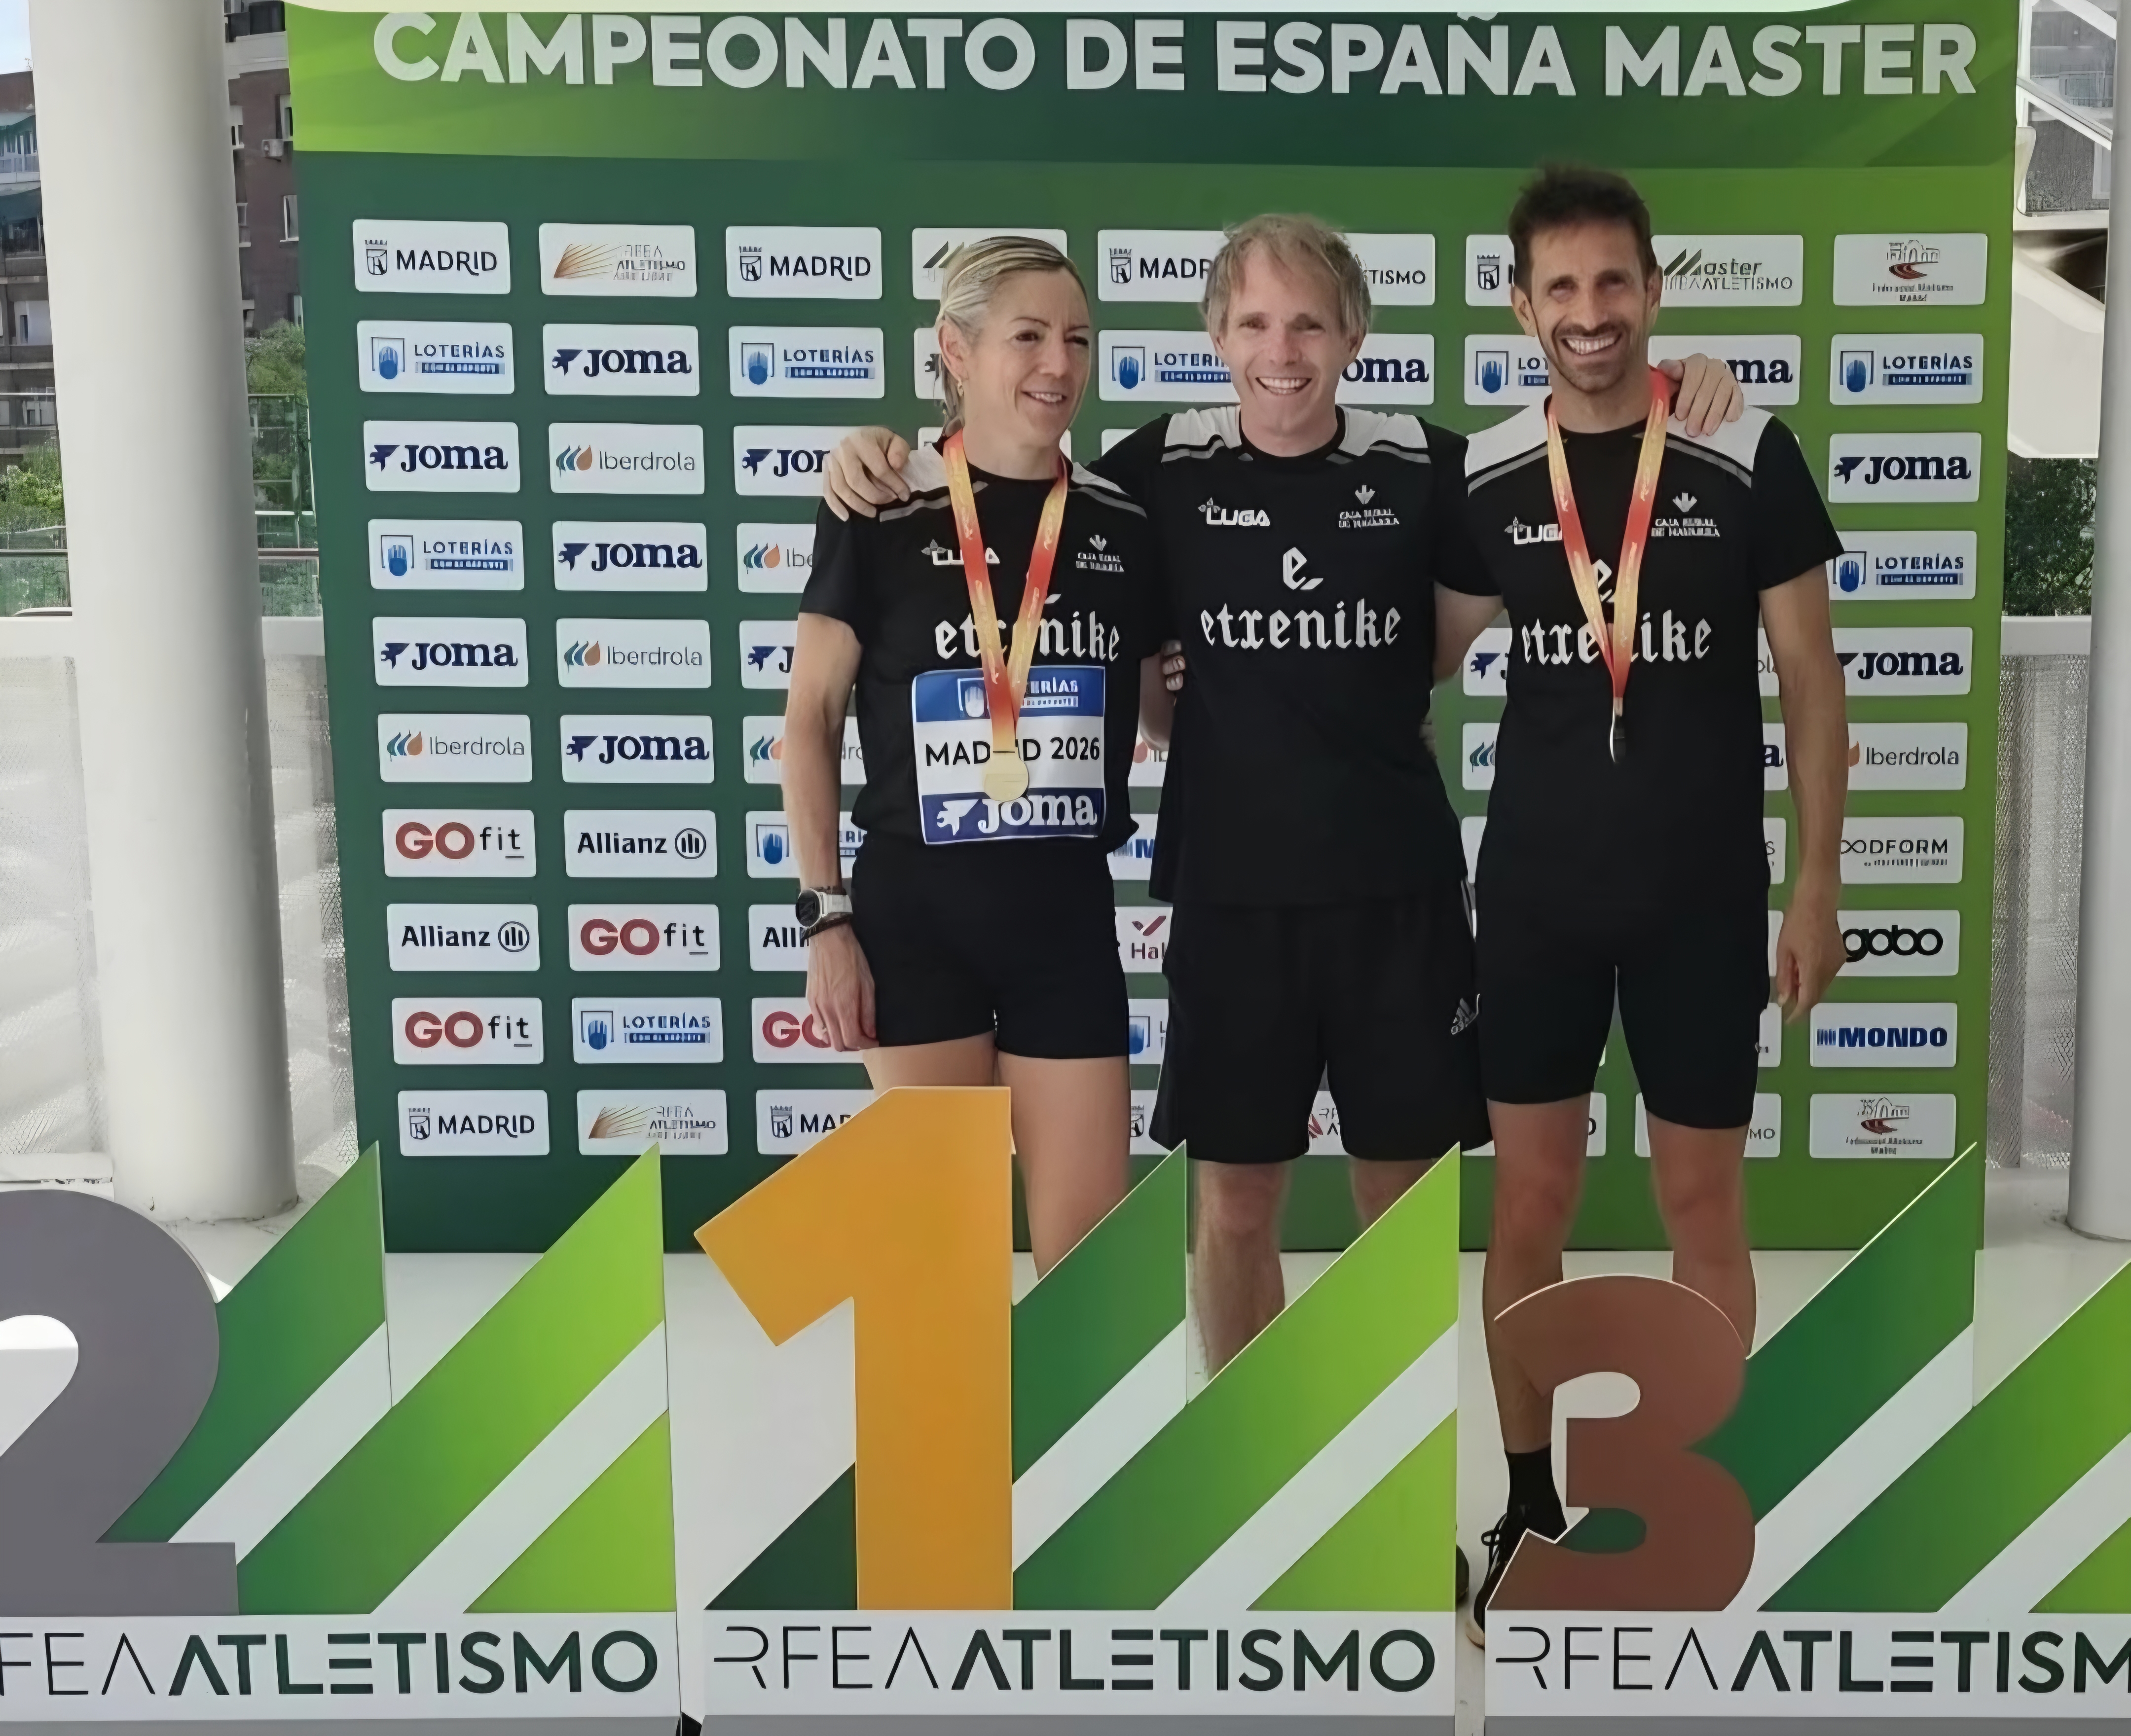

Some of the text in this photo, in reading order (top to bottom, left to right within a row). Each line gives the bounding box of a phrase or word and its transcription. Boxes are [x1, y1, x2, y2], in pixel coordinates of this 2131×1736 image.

[373, 12, 1977, 97] CAMPEONATO DE ESPAÑA MASTER
[396, 250, 497, 277] MADRID
[771, 255, 871, 282] MADRID
[1139, 257, 1212, 279] MADR
[1368, 269, 1426, 285] TISMO
[1341, 358, 1430, 383] oma
[1726, 359, 1793, 384] ma
[599, 450, 695, 471] Iberdrola
[935, 611, 1120, 662] etnike
[1200, 598, 1401, 650] etxenike
[1521, 609, 1712, 665] etxeike
[607, 645, 702, 666] Iberdrola
[430, 735, 525, 756] Iberdrola
[925, 737, 1100, 766] MADD 2026
[1866, 746, 1959, 765] Iberdrola
[577, 832, 667, 854] Allianz
[402, 925, 491, 947] Allianz
[1838, 1027, 1948, 1048] MONDO
[439, 1114, 535, 1138] MADRID
[694, 1087, 1013, 1610] 1
[0, 1189, 239, 1616] 2
[1486, 1274, 1756, 1611] 3
[0, 1632, 155, 1696] FEA
[1730, 1630, 2131, 1693] ATLETISM
